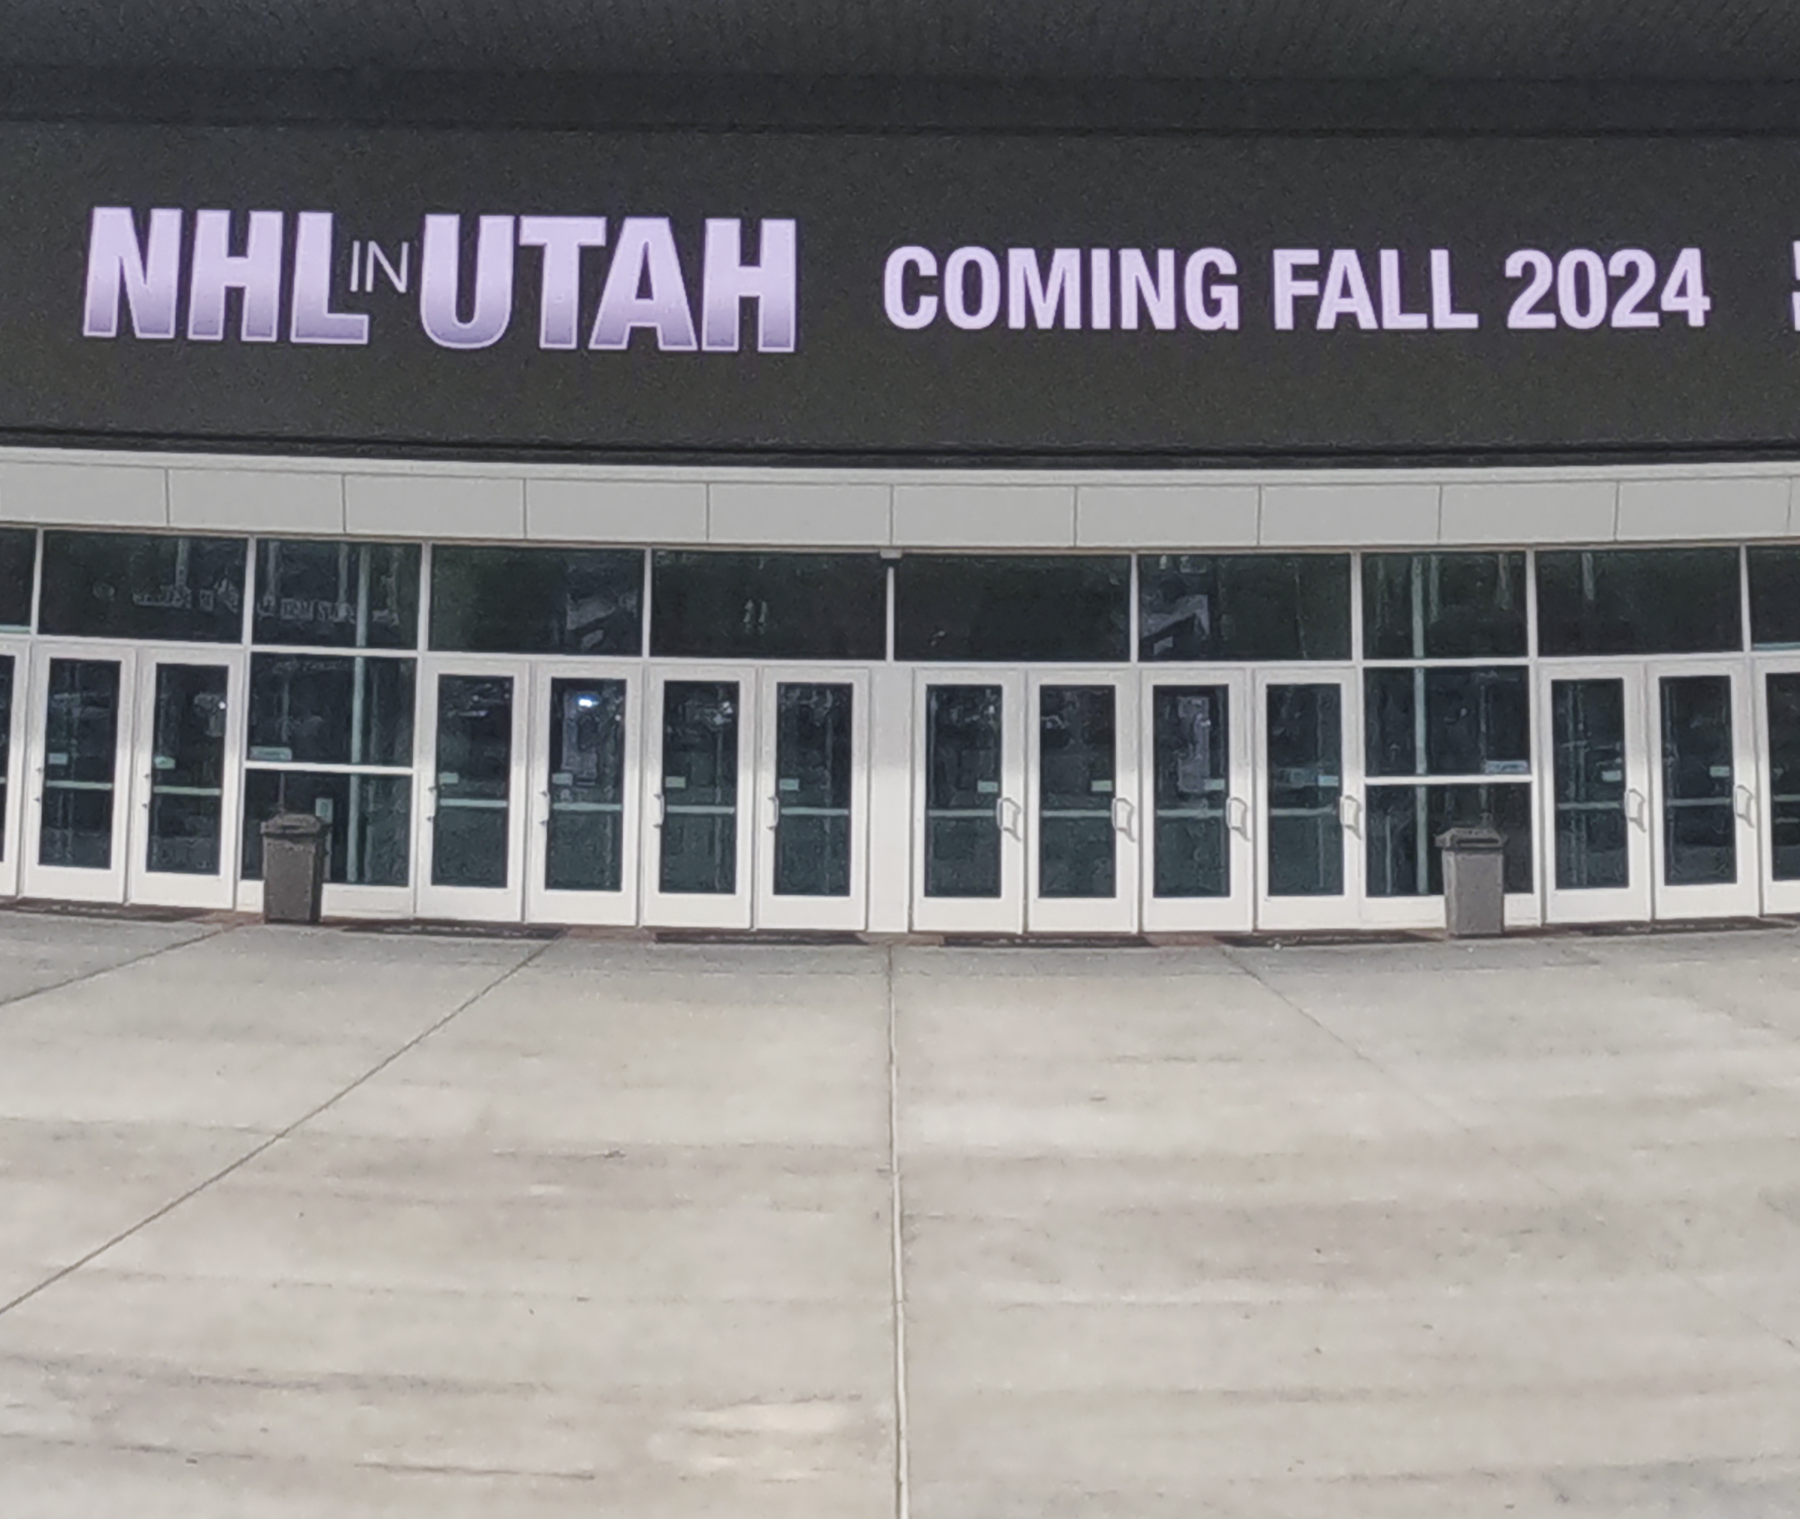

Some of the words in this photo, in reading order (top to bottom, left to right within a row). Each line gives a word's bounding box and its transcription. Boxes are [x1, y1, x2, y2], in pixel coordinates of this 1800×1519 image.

[84, 207, 369, 344] NHL
[350, 240, 408, 293] IN
[419, 214, 797, 352] UTAH
[883, 246, 1240, 330] COMING
[1273, 248, 1478, 330] FALL
[1506, 247, 1712, 329] 2024
